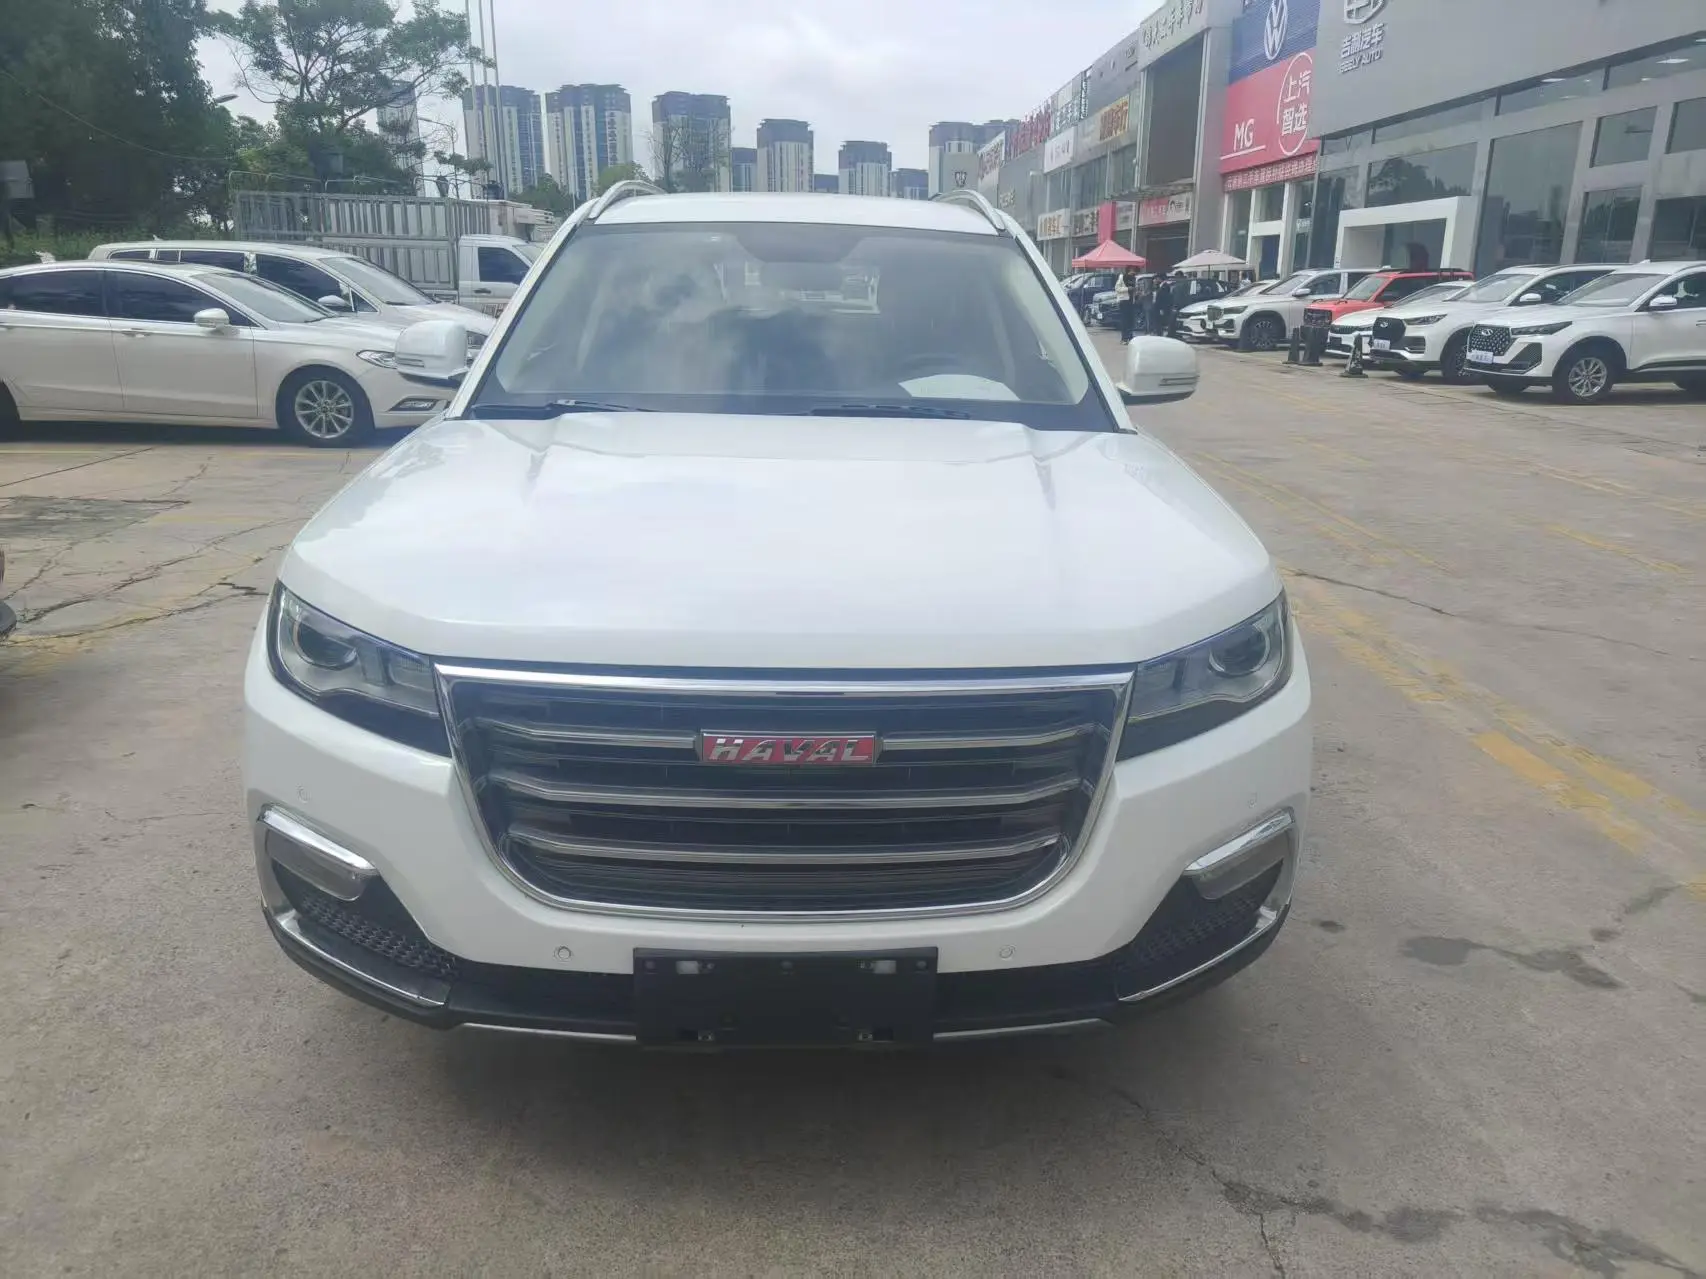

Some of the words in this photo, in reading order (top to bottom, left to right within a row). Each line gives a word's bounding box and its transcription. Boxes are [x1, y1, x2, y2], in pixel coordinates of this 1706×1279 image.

[1340, 23, 1385, 58] 吉利汽车
[1361, 50, 1382, 65] AUTO
[1284, 69, 1311, 103] 上汽
[1233, 118, 1255, 152] MG
[1281, 103, 1309, 136] 智选
[709, 738, 869, 762] HAVAL
